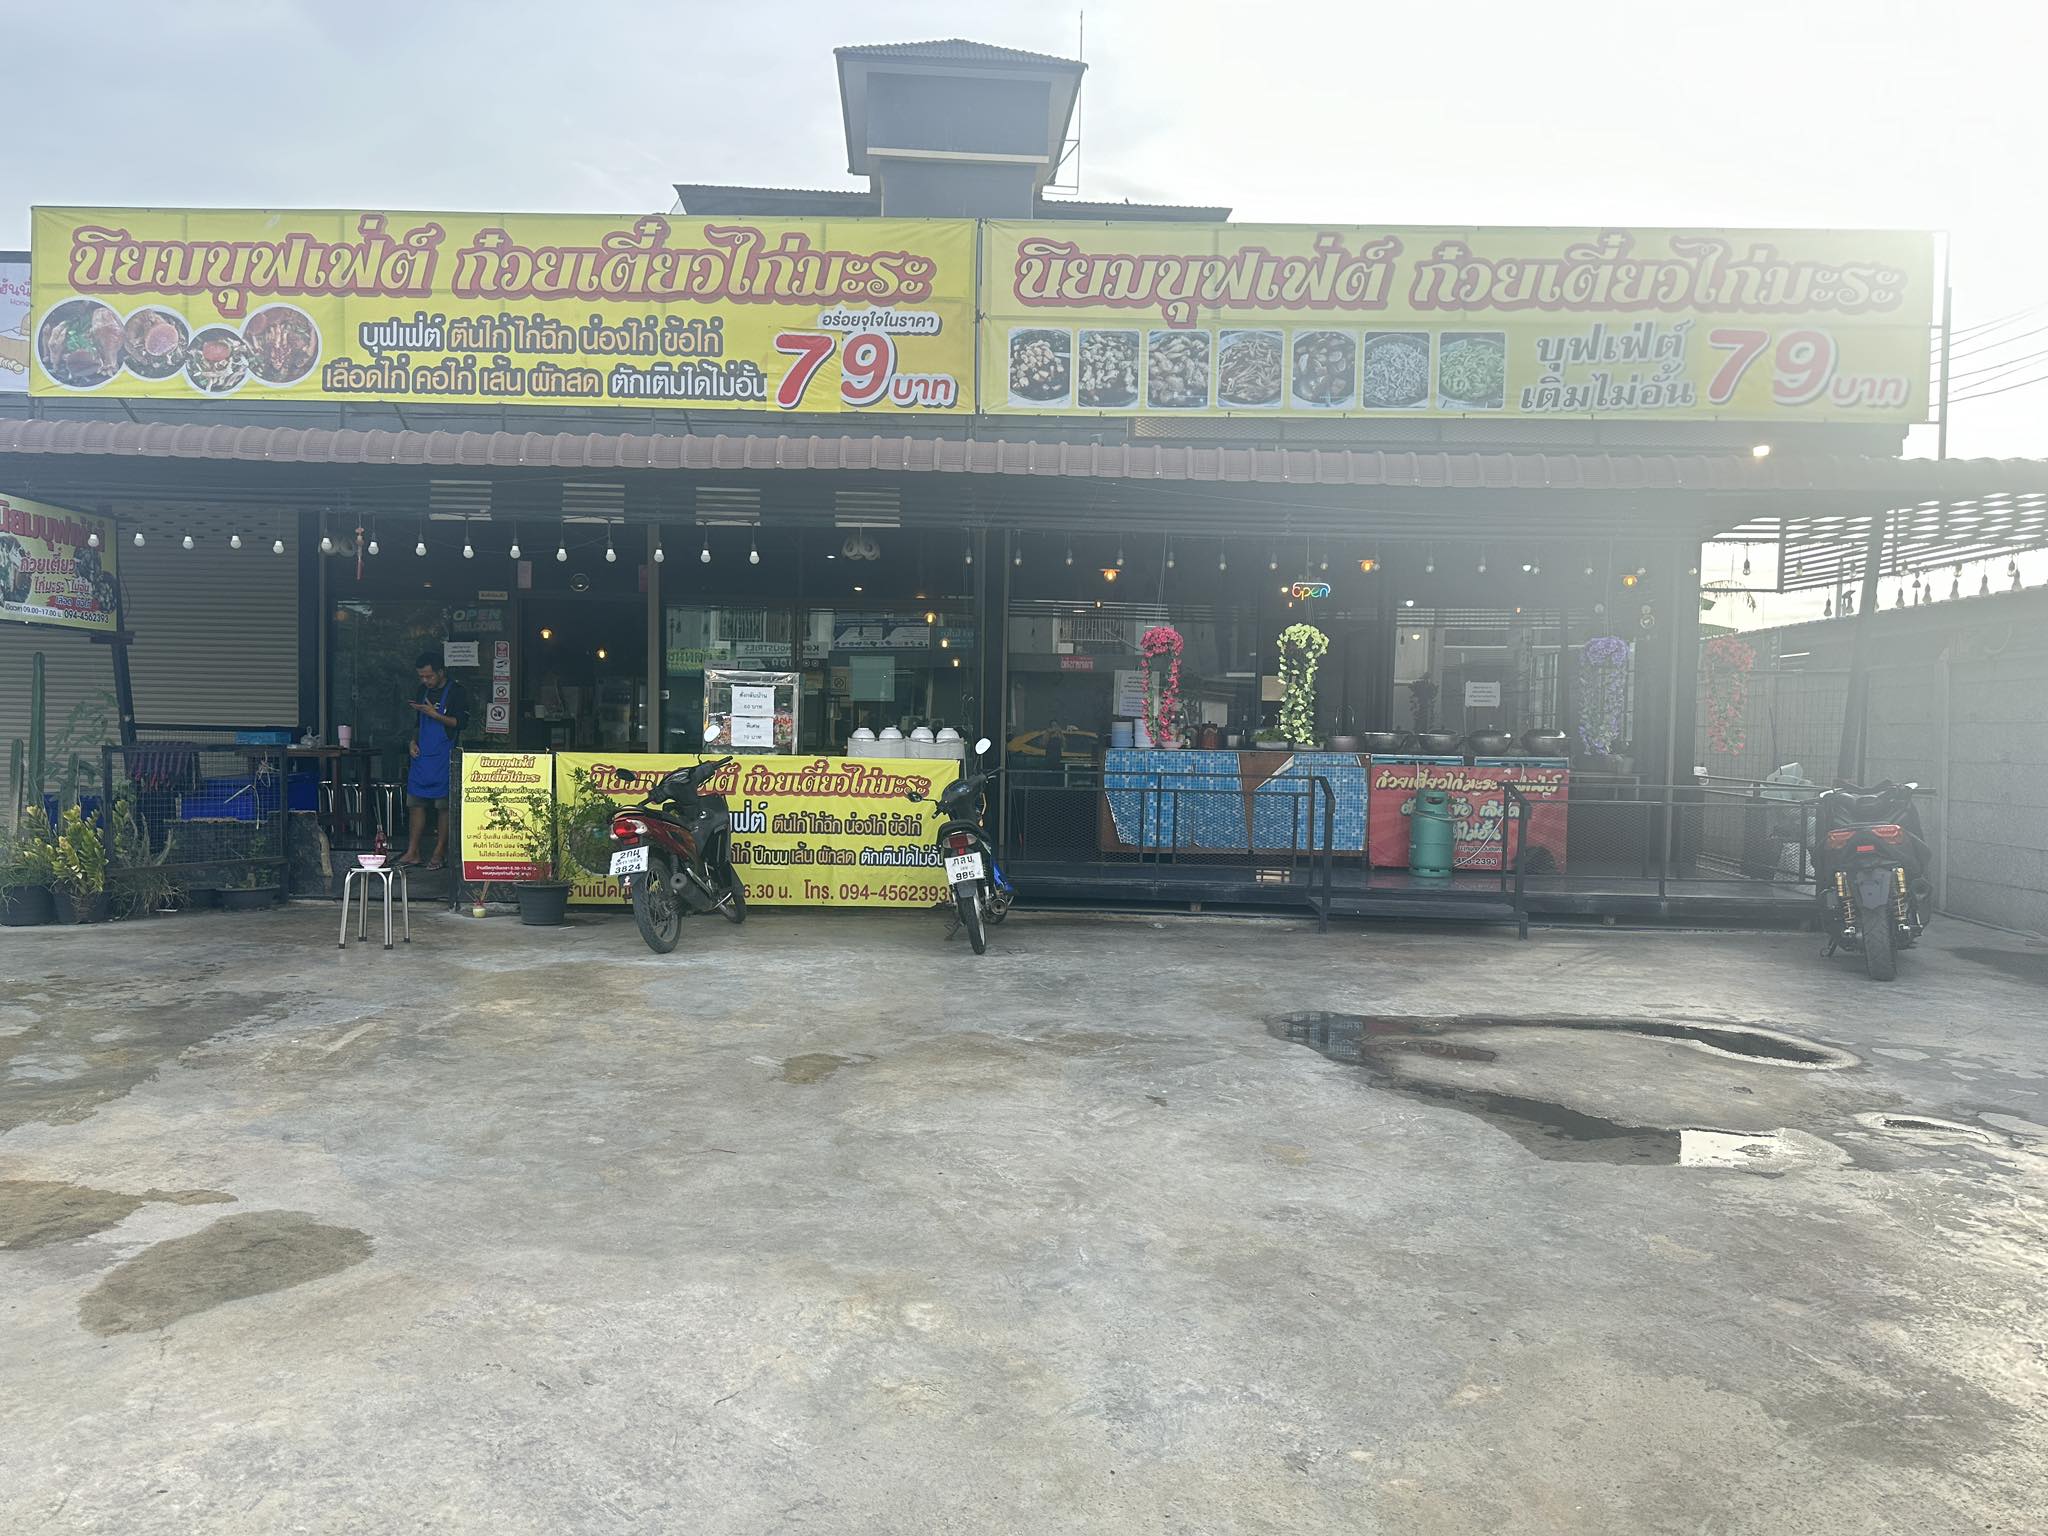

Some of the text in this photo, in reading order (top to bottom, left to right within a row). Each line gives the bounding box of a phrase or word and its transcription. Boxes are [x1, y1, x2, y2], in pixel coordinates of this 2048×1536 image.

[70, 214, 937, 318] นิยมบุฟเฟ่ต์ ก๋วยเตี๋ยวไก่มะระ
[1014, 231, 1907, 328] นิยมบุฟเฟ่ต์ ก๋วยเตี๋ยวไก่มะระ
[360, 313, 723, 356] บุฟเฟ่ต์ ตีนไก่ ไก่ฉีก น่องไก่ ข้อไก่
[820, 309, 939, 334] อร่อยจุใจในราคา
[1535, 320, 1694, 371] บุฟเฟ่ต์
[323, 356, 767, 400] เลือดไก่ คอไก่ เส้น ผักสด ตักเติมได้ไม่อั้น
[773, 330, 957, 411] 79 บาท
[1520, 362, 1699, 415] เติมไม่อั้น
[1707, 327, 1911, 409] 79 บาท
[742, 759, 932, 799] ก๋วยเตี๋ยวไก่มะระ
[772, 811, 808, 833] ตีนไก่
[809, 811, 841, 834] ไก่ฉีก
[844, 811, 888, 835] น่องไก่
[889, 813, 922, 836] ข้อไก่
[615, 863, 641, 874] 3824
[753, 845, 790, 866] ปีกบน
[790, 842, 813, 864] เส้น
[816, 846, 855, 866] ผักสด
[804, 879, 833, 900] โทร.
[839, 884, 948, 902] 094-4562393
